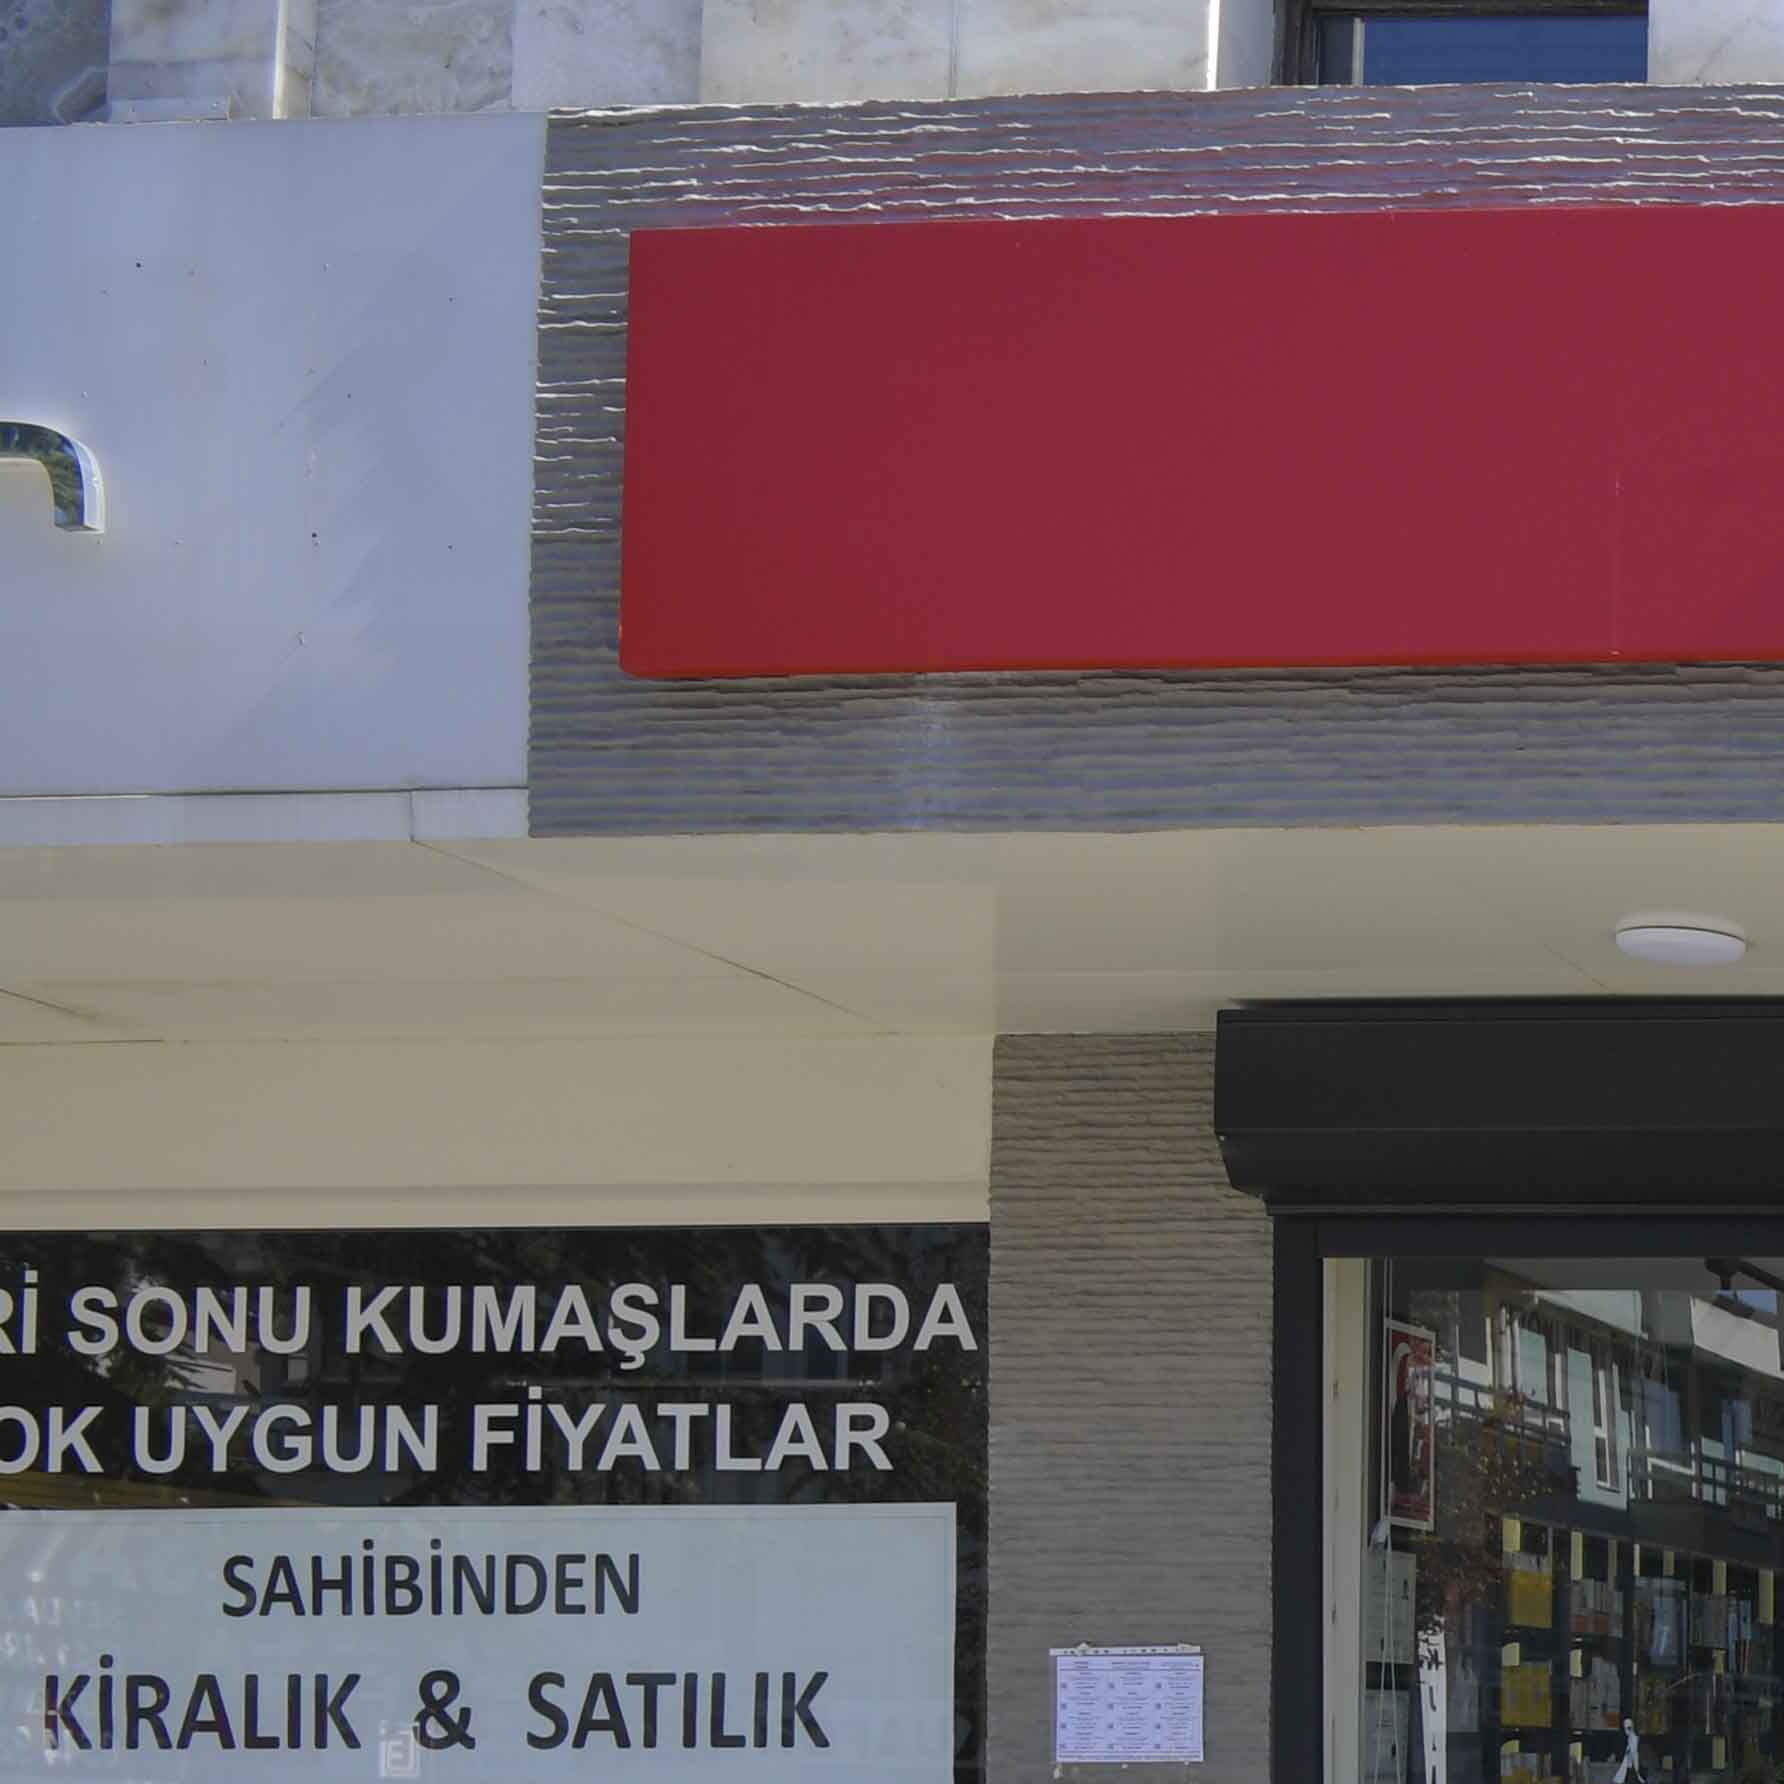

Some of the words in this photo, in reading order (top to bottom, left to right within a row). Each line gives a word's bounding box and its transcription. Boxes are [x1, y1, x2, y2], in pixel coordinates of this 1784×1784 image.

[68, 1286, 310, 1354] SONU
[346, 1283, 977, 1369] KUMAŞLARDA
[135, 1404, 438, 1474] UYGUN
[474, 1387, 894, 1472] FİYATLAR
[221, 1538, 642, 1617] SAHİBİNDEN
[44, 1655, 362, 1750] KİRALIK
[414, 1670, 476, 1750] &
[526, 1671, 831, 1749] SATILIK
